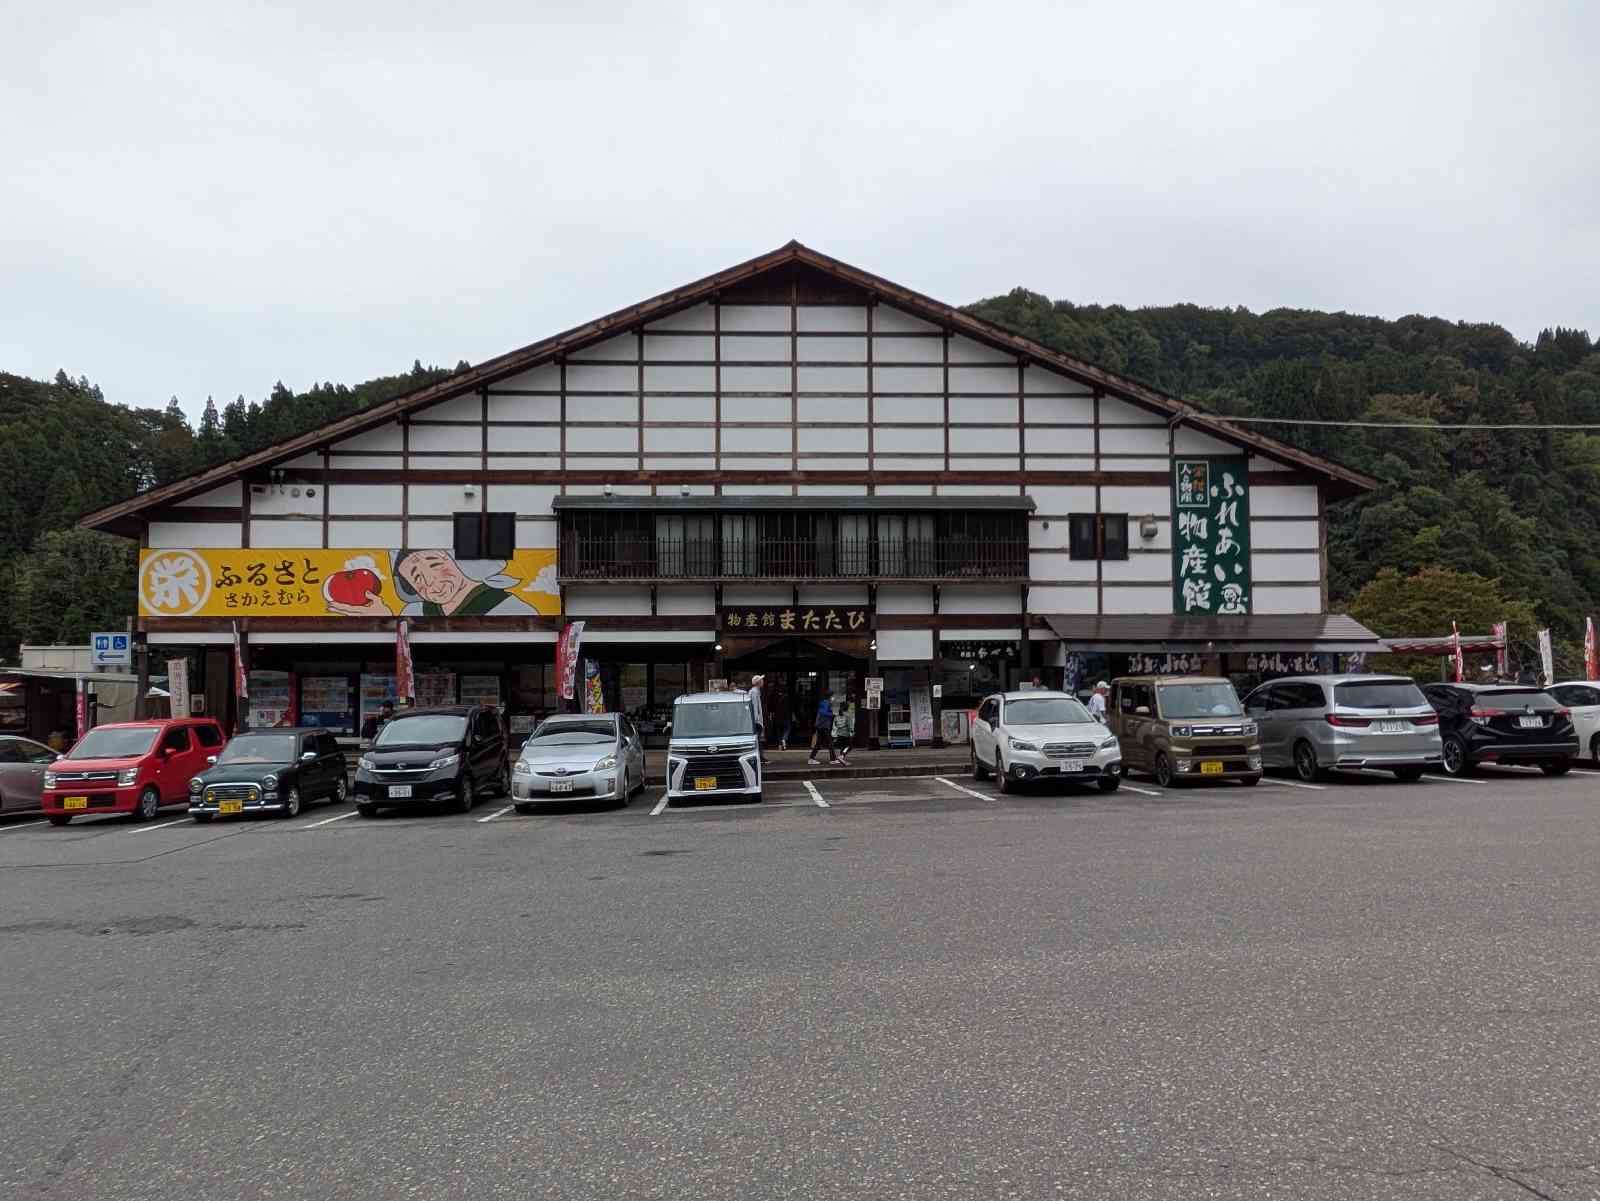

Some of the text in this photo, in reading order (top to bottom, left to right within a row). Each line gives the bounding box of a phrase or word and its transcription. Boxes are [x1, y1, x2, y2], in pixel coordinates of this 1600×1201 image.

[1210, 472, 1245, 582] ふれあい
[215, 558, 320, 589] ふるさと
[1178, 511, 1212, 611] 物産館
[225, 588, 311, 608] さかえむら
